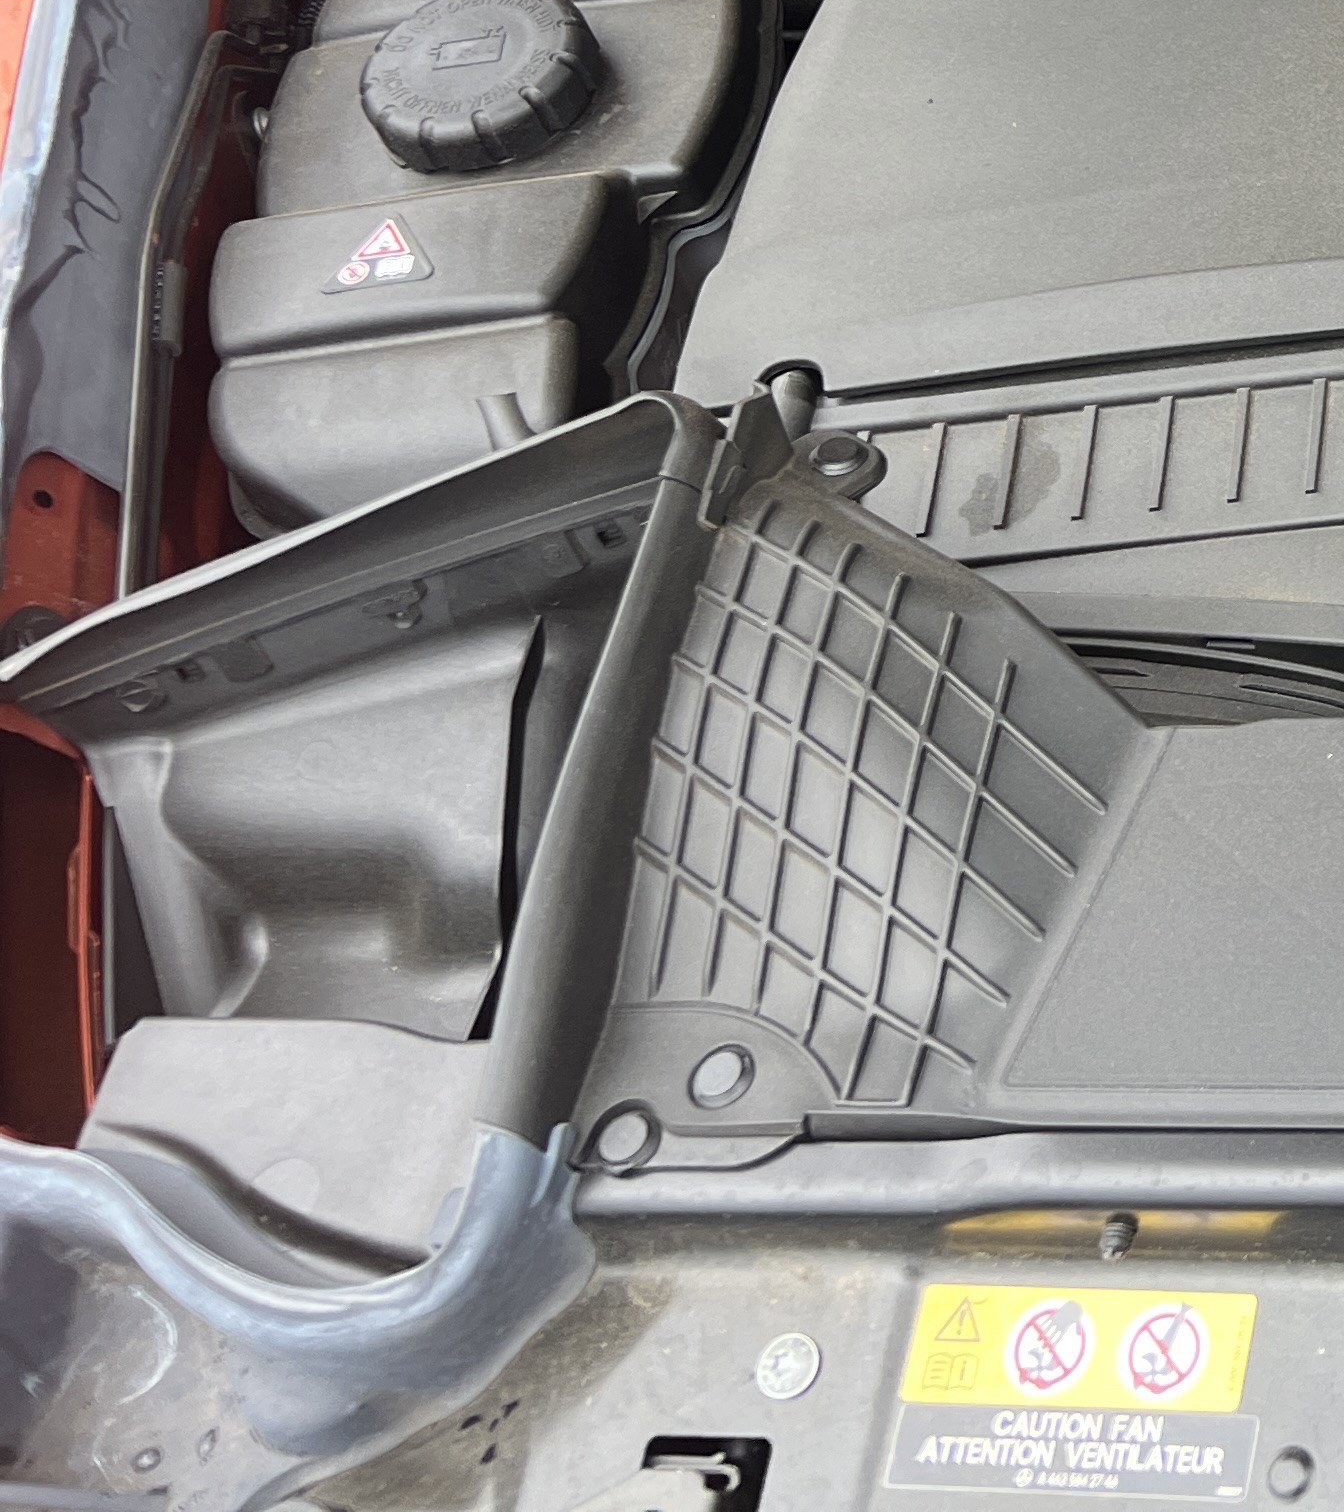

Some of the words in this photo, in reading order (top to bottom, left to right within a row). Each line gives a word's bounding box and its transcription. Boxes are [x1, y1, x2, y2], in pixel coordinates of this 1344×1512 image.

[992, 1409, 1103, 1440] CAUTION
[1108, 1413, 1165, 1443] FAN
[916, 1434, 1056, 1469] ATTENTION
[1065, 1440, 1225, 1474] VENTILATEUR
